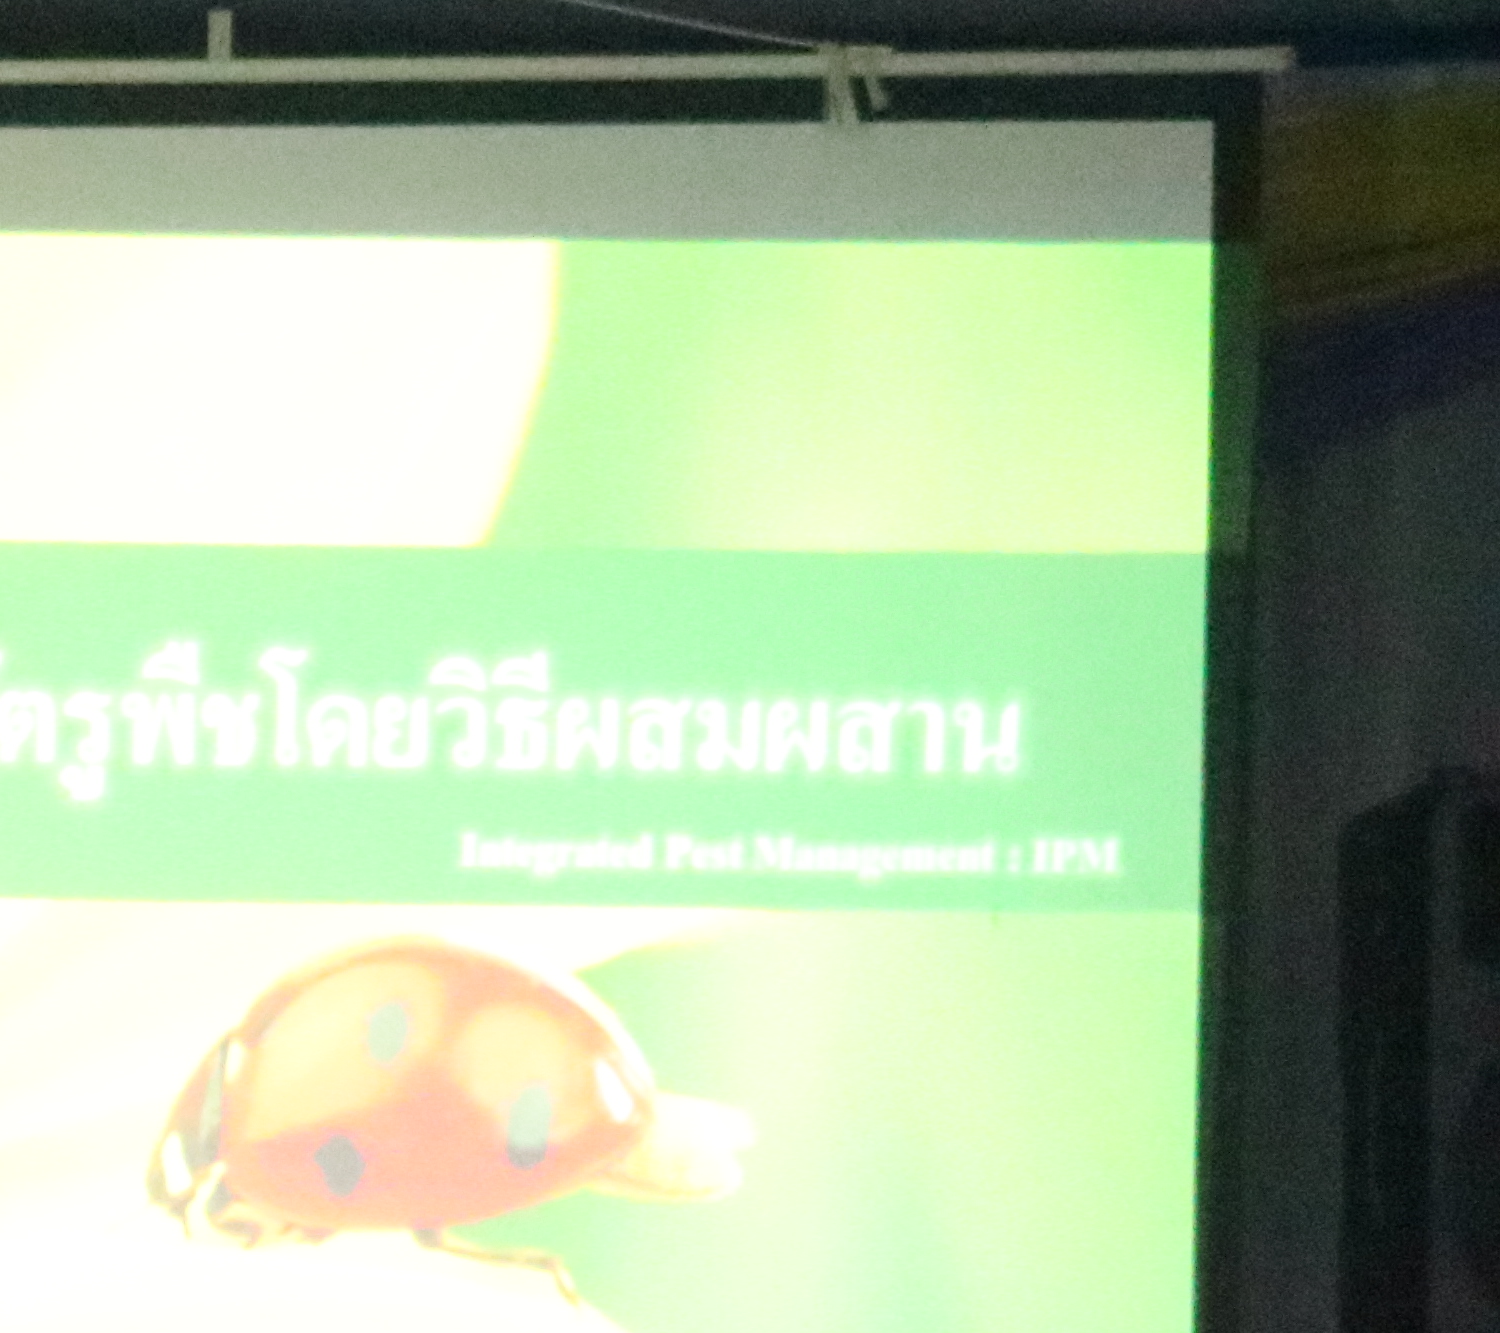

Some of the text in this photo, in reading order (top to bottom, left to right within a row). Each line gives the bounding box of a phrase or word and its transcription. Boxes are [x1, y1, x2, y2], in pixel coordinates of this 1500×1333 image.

[459, 831, 652, 877] Integrated
[665, 834, 745, 871] Pest
[756, 835, 994, 879] Management
[1031, 837, 1123, 874] IPM
